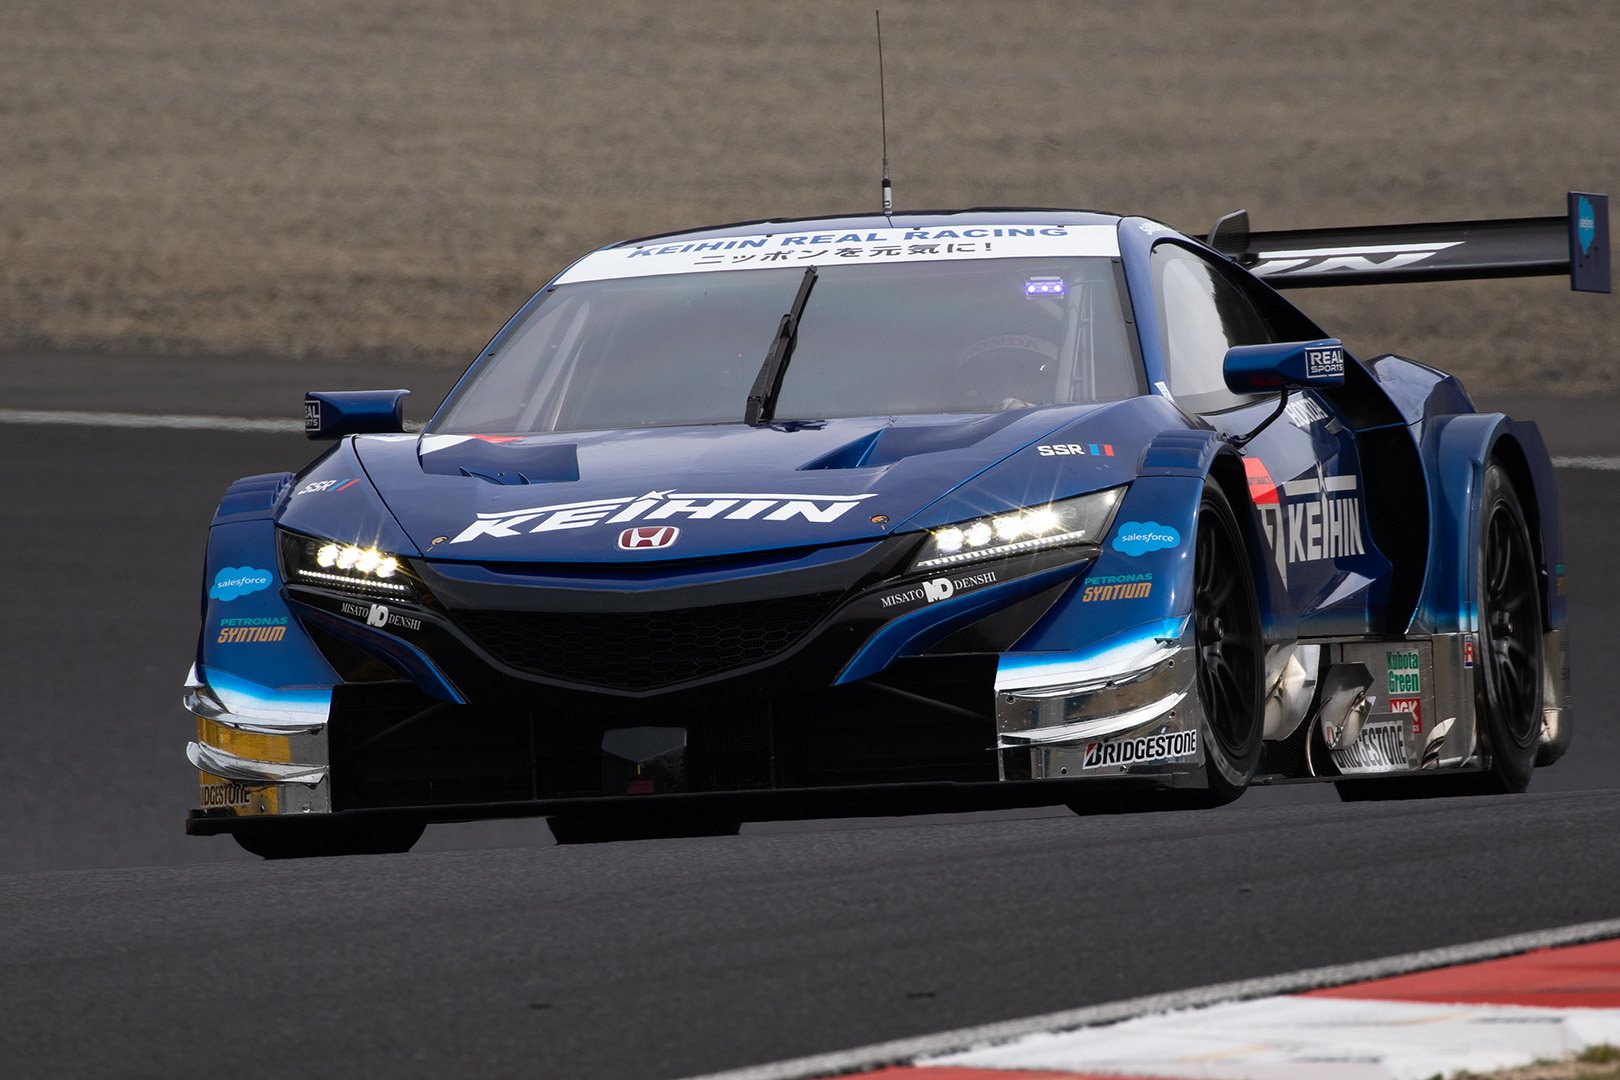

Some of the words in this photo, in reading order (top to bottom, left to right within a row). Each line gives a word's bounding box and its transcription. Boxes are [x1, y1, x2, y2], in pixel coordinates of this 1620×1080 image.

[627, 239, 767, 258] KEIHIN
[780, 232, 887, 246] REAL
[904, 228, 1068, 240] RACING
[1310, 350, 1343, 365] REAL
[1311, 364, 1343, 373] SPORTS
[1037, 444, 1085, 456] SSR
[297, 480, 337, 495] SSR
[450, 493, 879, 544] KEIHIN
[1122, 530, 1174, 543] salesforce
[1286, 493, 1365, 563] KEIHIN
[217, 577, 267, 589] salesforce
[1084, 573, 1152, 586] PETRONAS
[881, 589, 924, 608] MISATO
[954, 572, 997, 590] DENSHI
[1082, 582, 1152, 602] SYNTIUM
[220, 617, 288, 626] PETRONAS
[341, 602, 369, 618] MISATO
[388, 613, 421, 631] DENSHI
[217, 626, 286, 643] SYNTIUM
[1387, 652, 1419, 669] Kubota
[1388, 671, 1420, 692] Green
[1391, 700, 1418, 721] NGK
[1085, 731, 1196, 767] BRIDGESTONE
